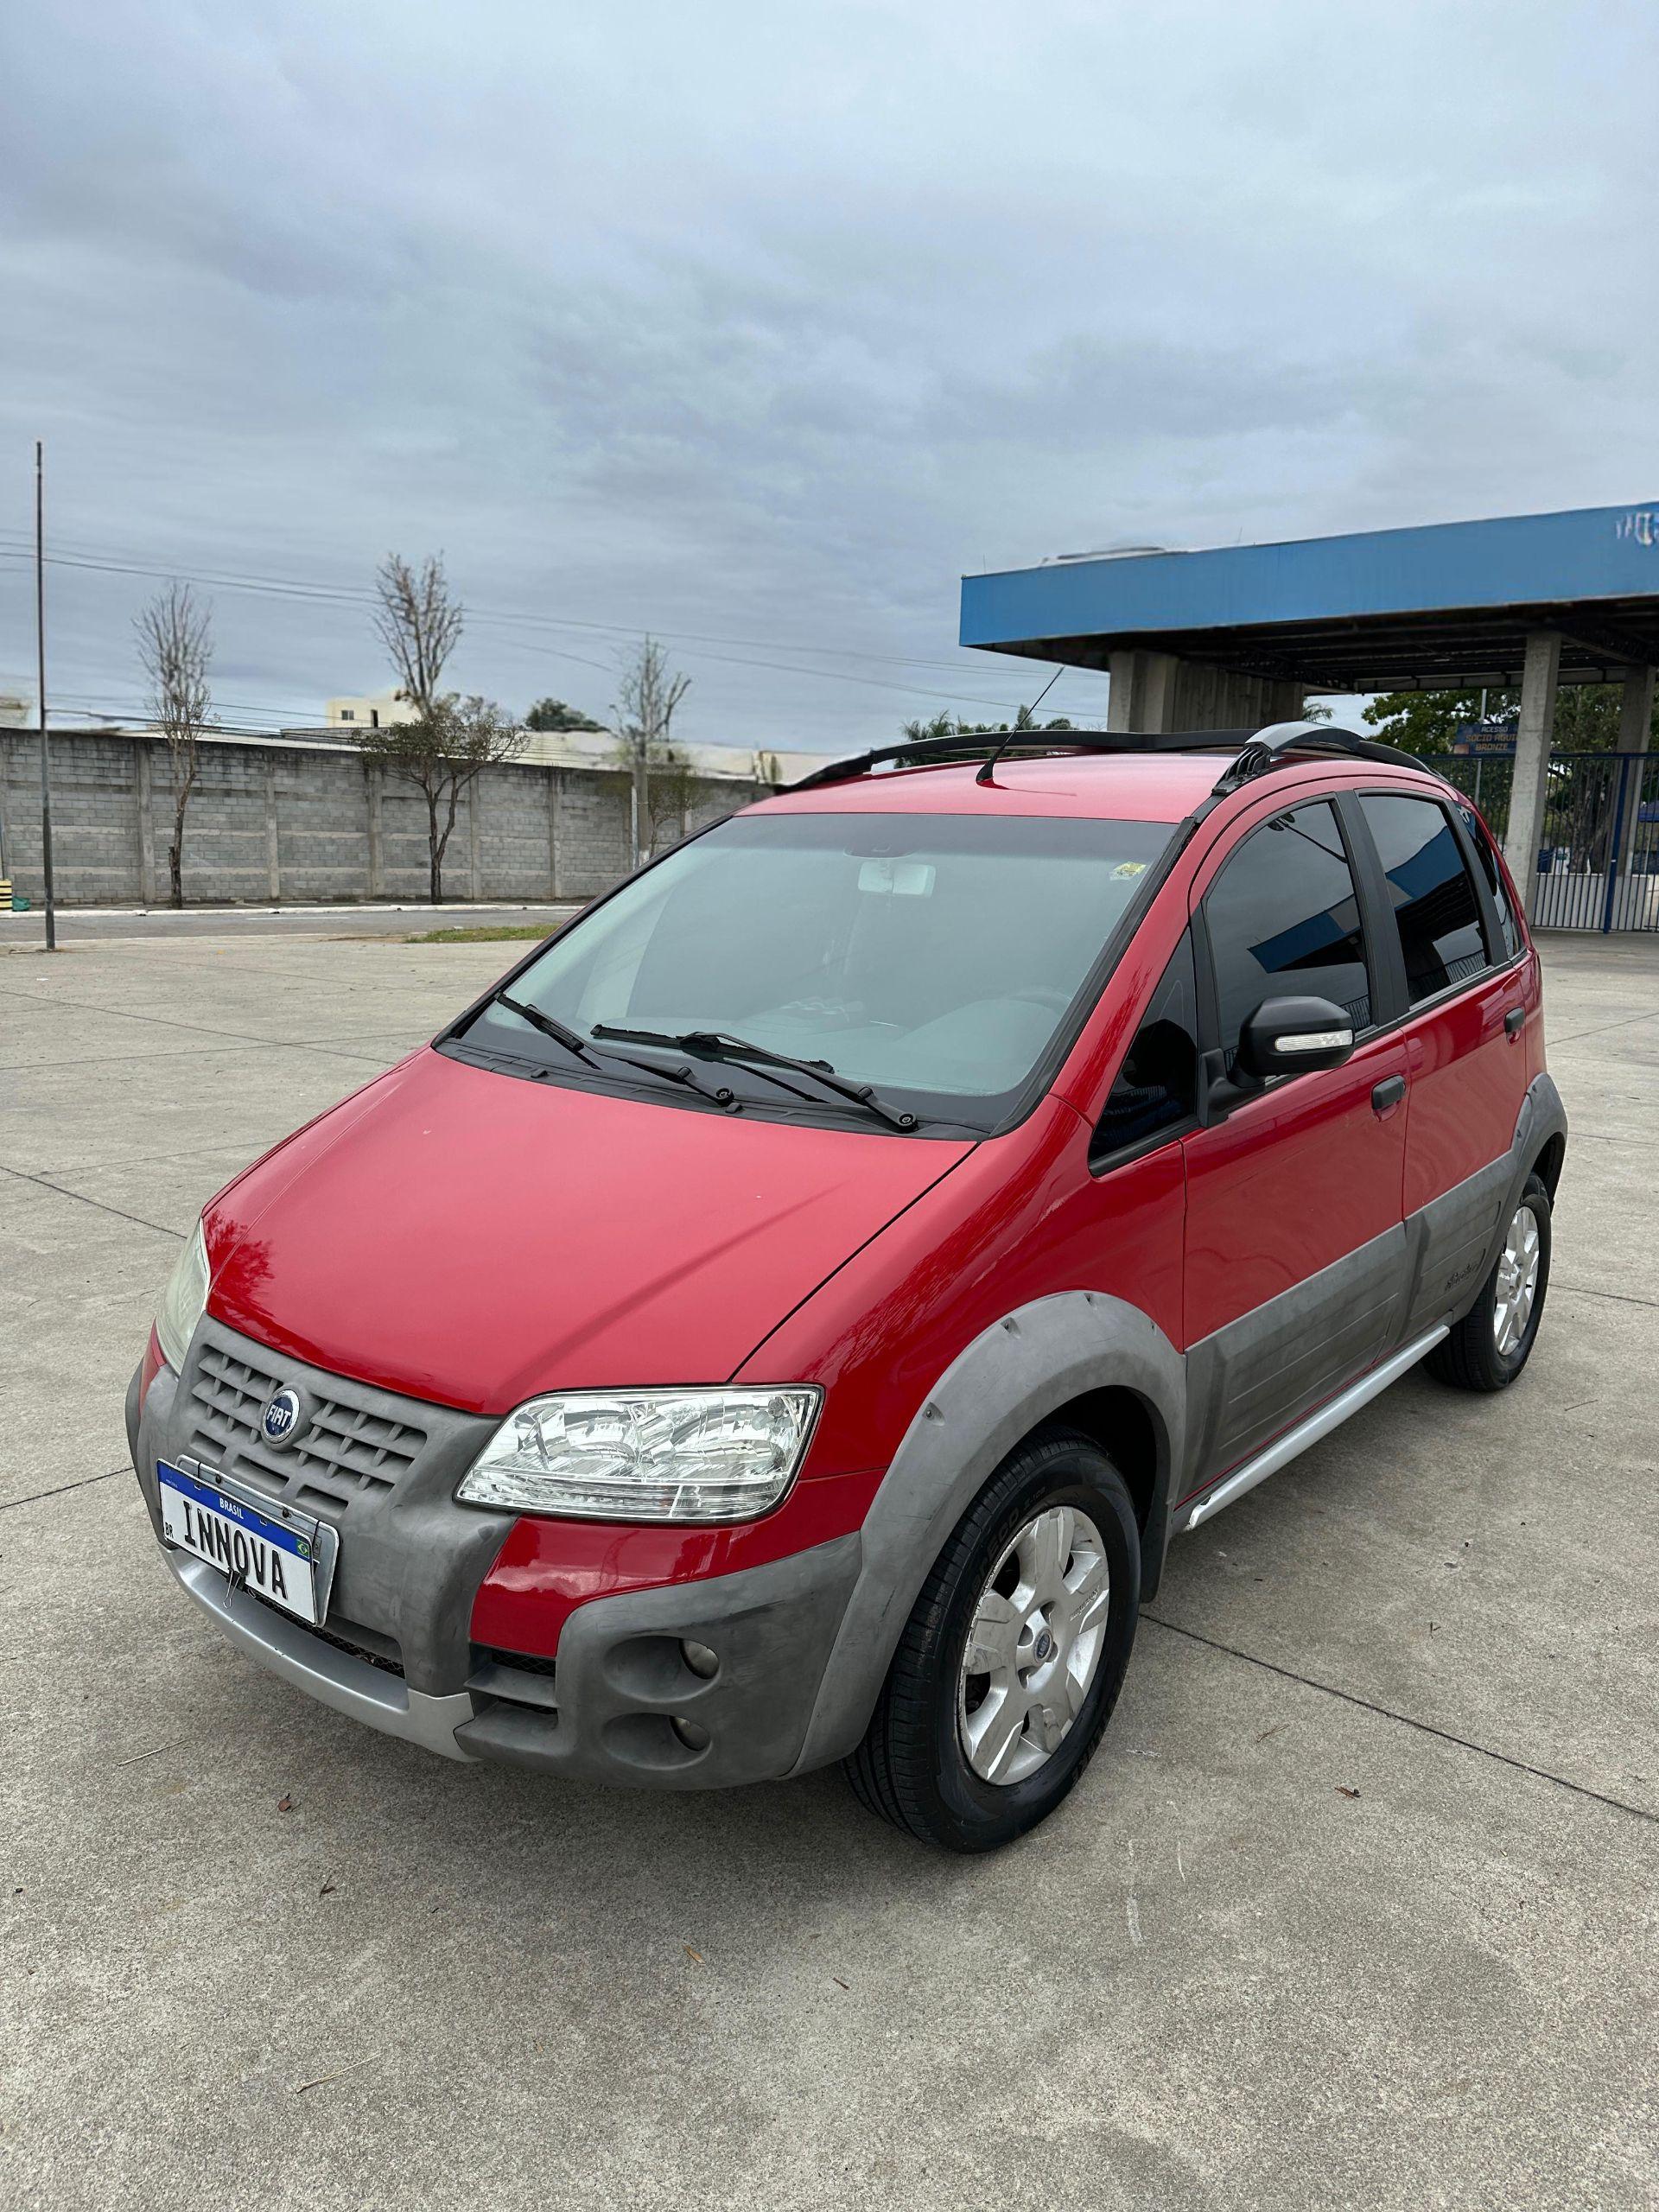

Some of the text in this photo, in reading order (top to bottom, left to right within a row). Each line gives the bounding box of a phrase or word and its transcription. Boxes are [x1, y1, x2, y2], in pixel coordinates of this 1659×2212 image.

[267, 1404, 292, 1427] FIAT
[219, 1497, 244, 1520] BRASIL
[165, 1522, 174, 1538] BR
[182, 1500, 288, 1599] INNOVA
